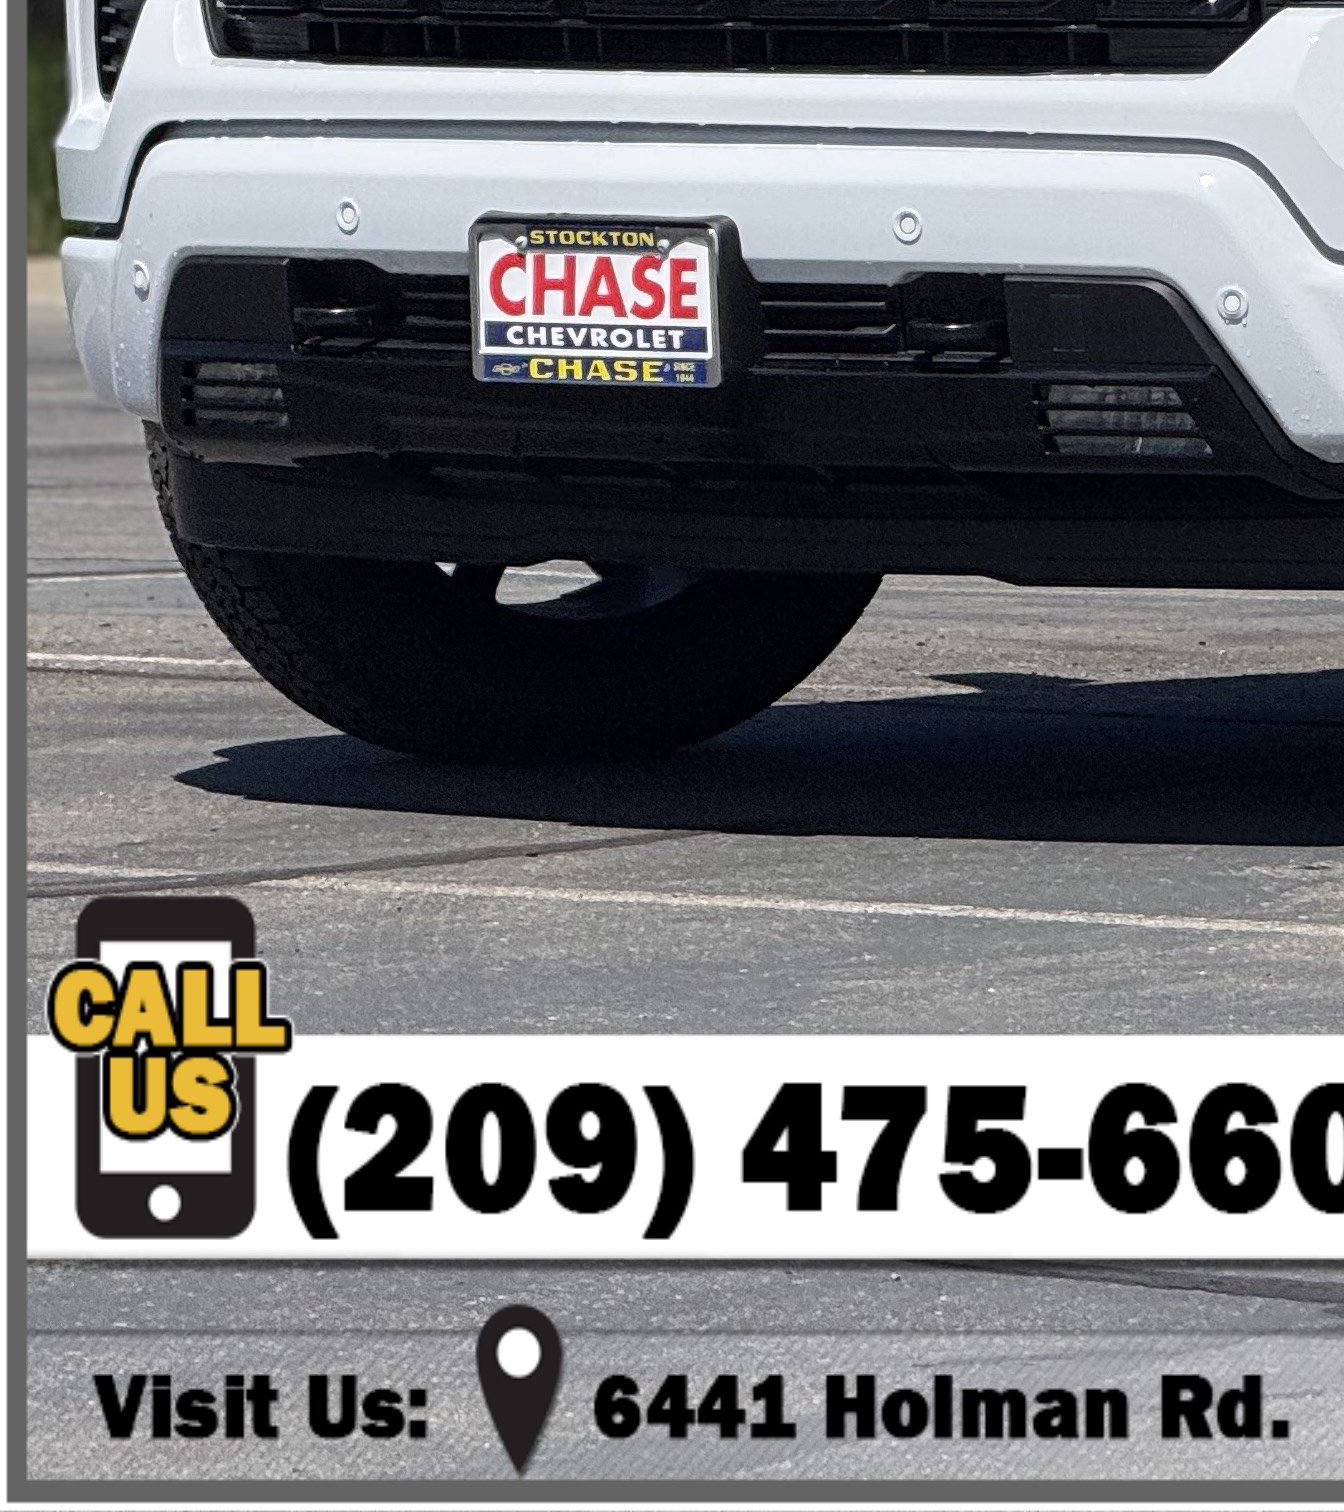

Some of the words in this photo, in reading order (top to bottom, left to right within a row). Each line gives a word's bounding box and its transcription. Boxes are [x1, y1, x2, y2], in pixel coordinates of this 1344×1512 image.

[529, 229, 655, 247] STOCKTON
[489, 252, 699, 319] CHASE
[506, 325, 684, 349] CHEVROLET
[529, 358, 665, 382] CHASE
